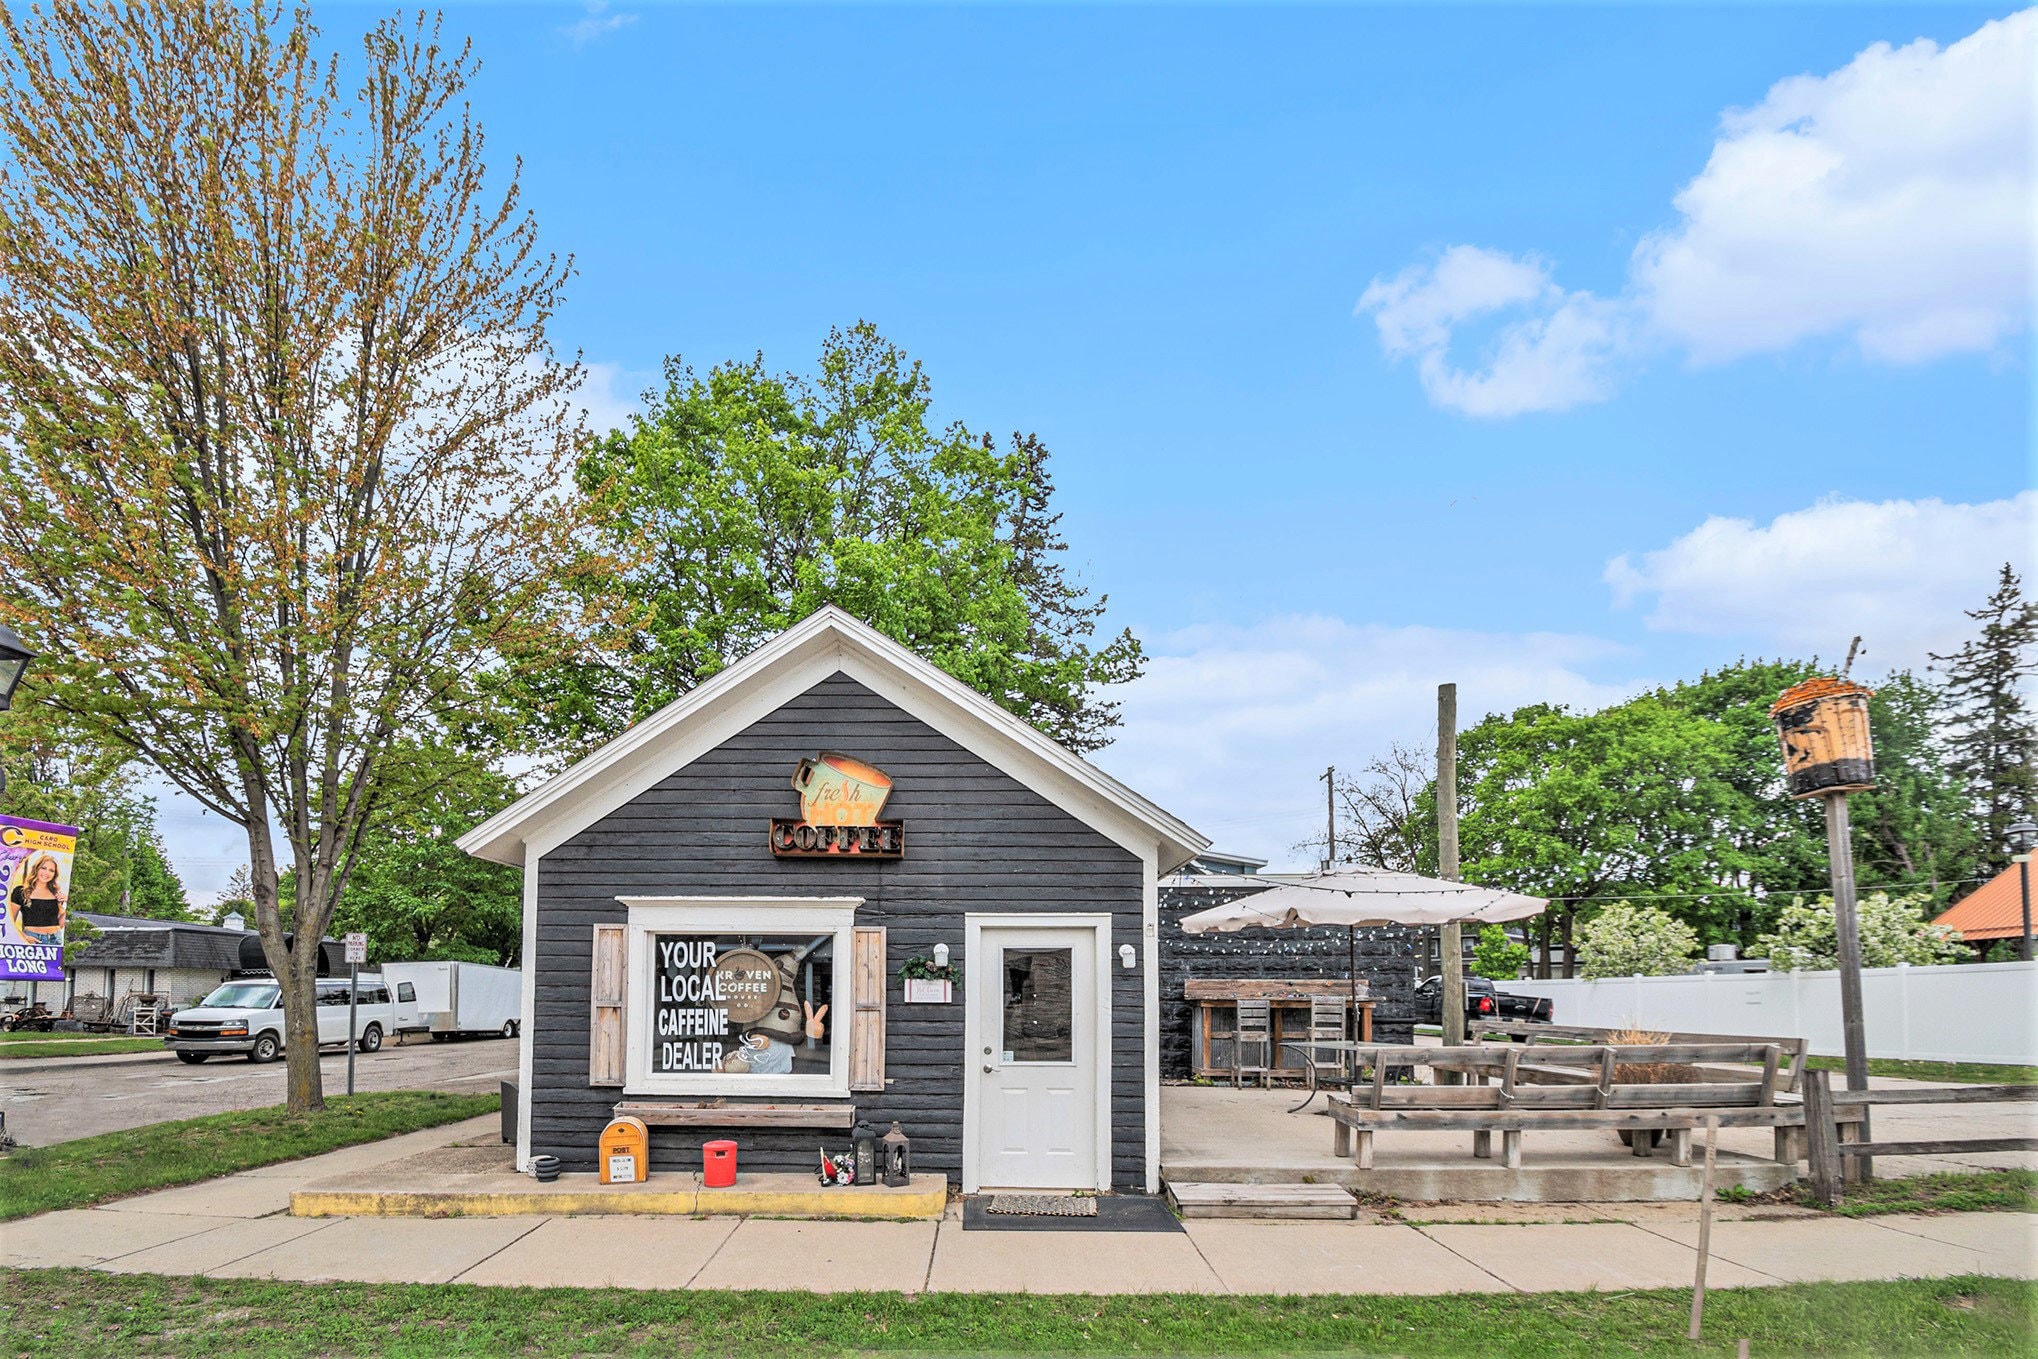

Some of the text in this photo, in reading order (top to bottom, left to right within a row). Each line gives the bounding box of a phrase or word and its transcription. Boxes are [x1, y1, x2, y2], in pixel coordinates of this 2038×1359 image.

[810, 801, 875, 826] HOT
[43, 841, 70, 850] SCHOOL
[773, 824, 901, 851] COFFEE
[8, 959, 47, 974] LONG
[660, 941, 717, 968] YOUR
[661, 975, 726, 1002] LOCAL
[719, 982, 768, 993] COFFEE
[658, 1008, 729, 1036] CAFFEINE
[662, 1042, 723, 1070] DEALER
